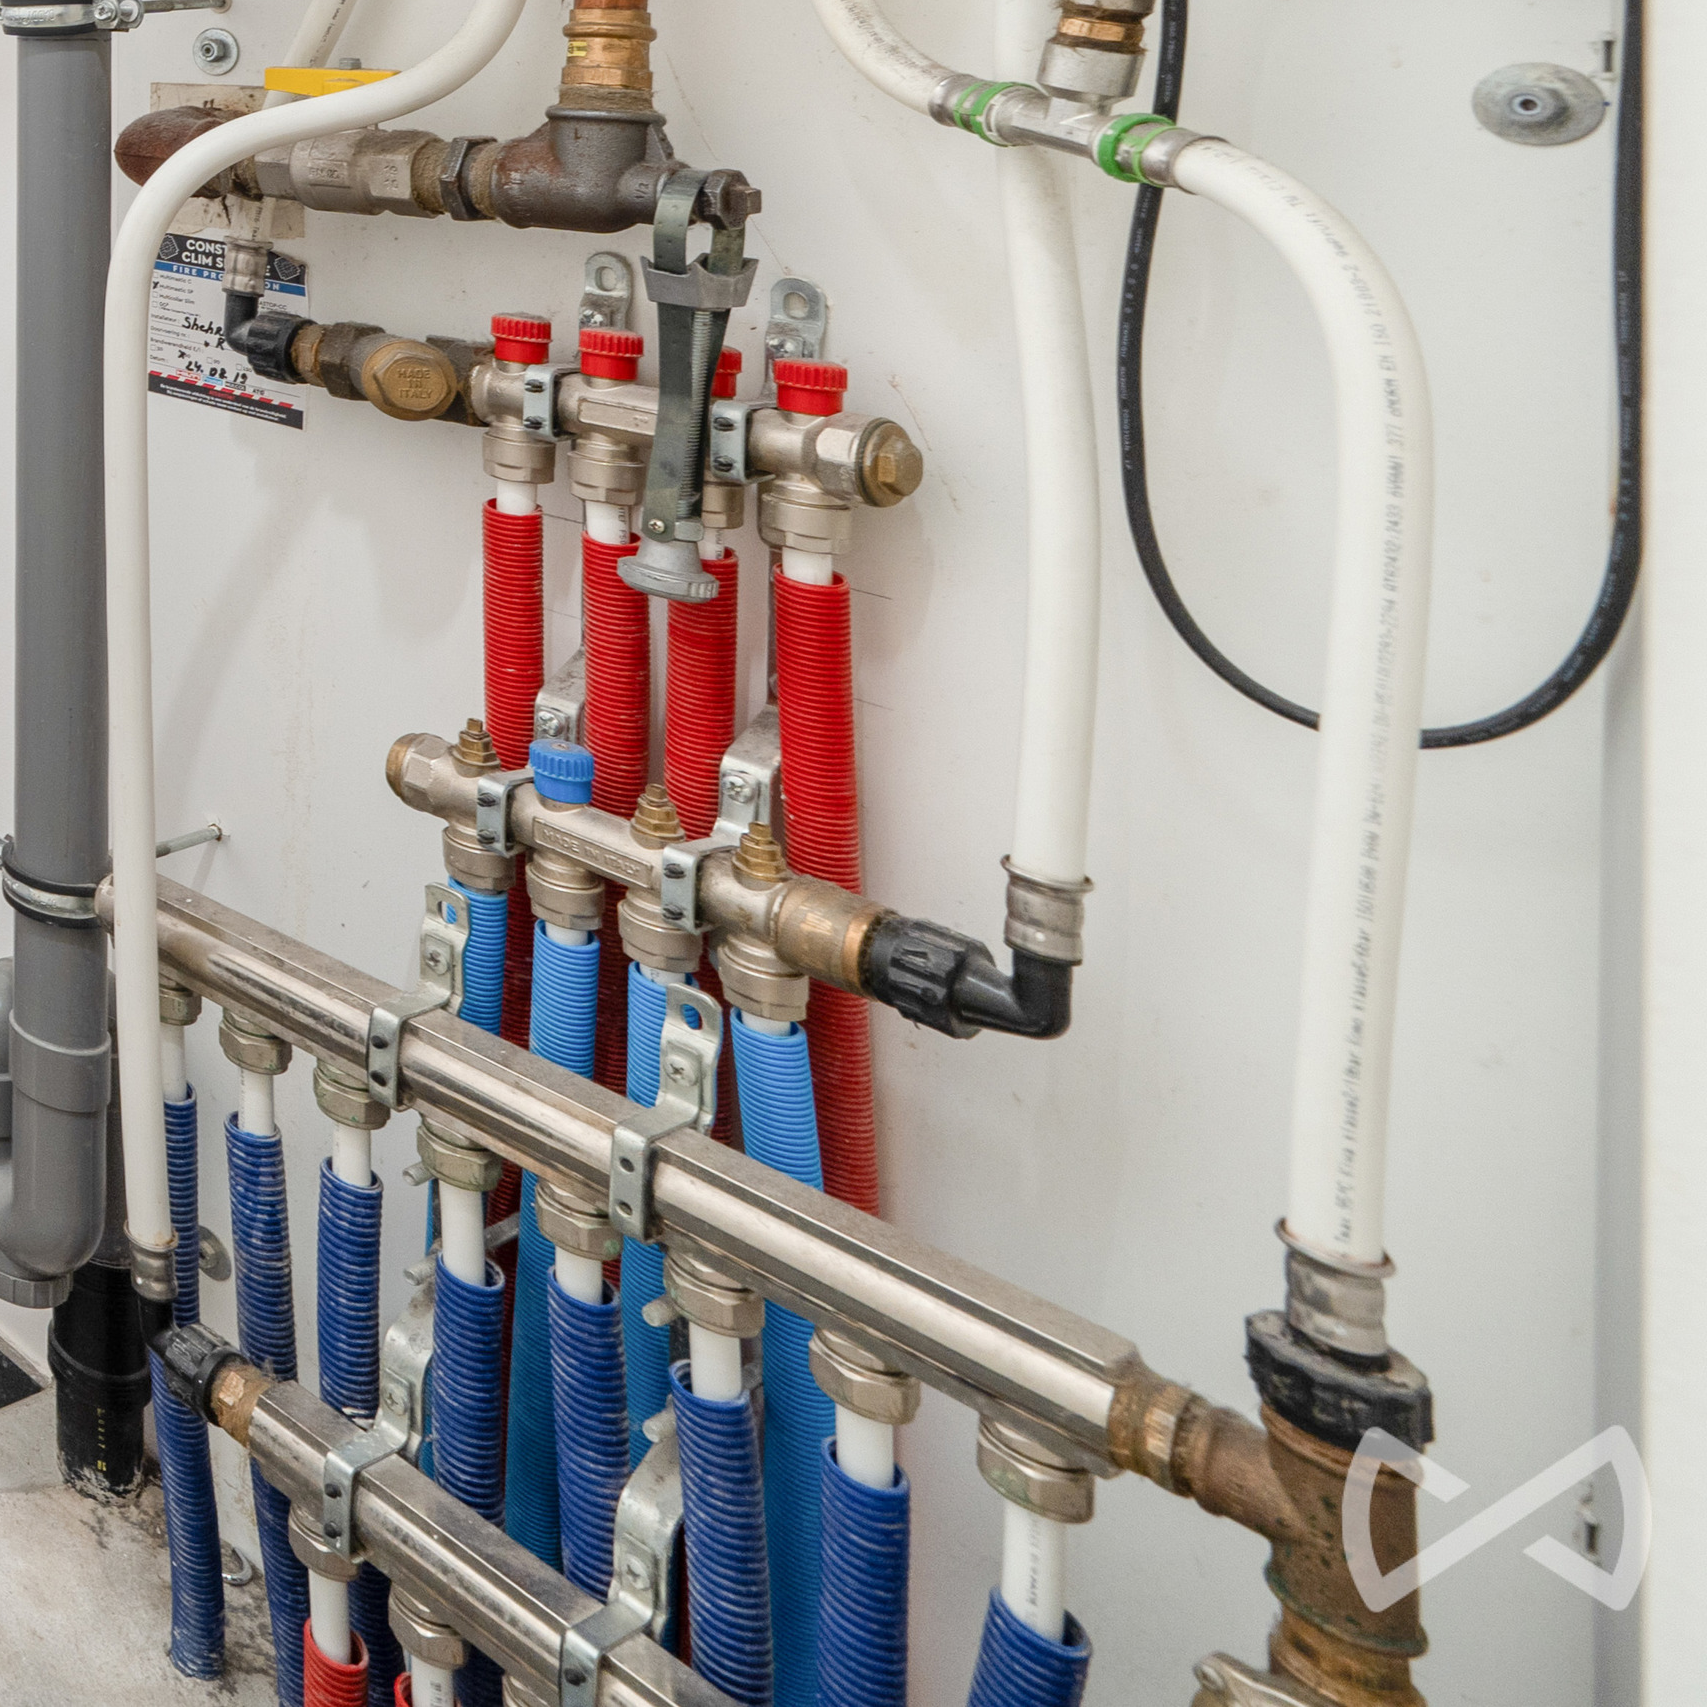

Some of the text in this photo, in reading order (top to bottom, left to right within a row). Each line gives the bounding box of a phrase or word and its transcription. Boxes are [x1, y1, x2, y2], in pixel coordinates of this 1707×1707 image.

[181, 252, 213, 267] CLIM
[172, 265, 198, 276] FIRE
[396, 368, 431, 379] MADE
[398, 388, 432, 399] ITALY
